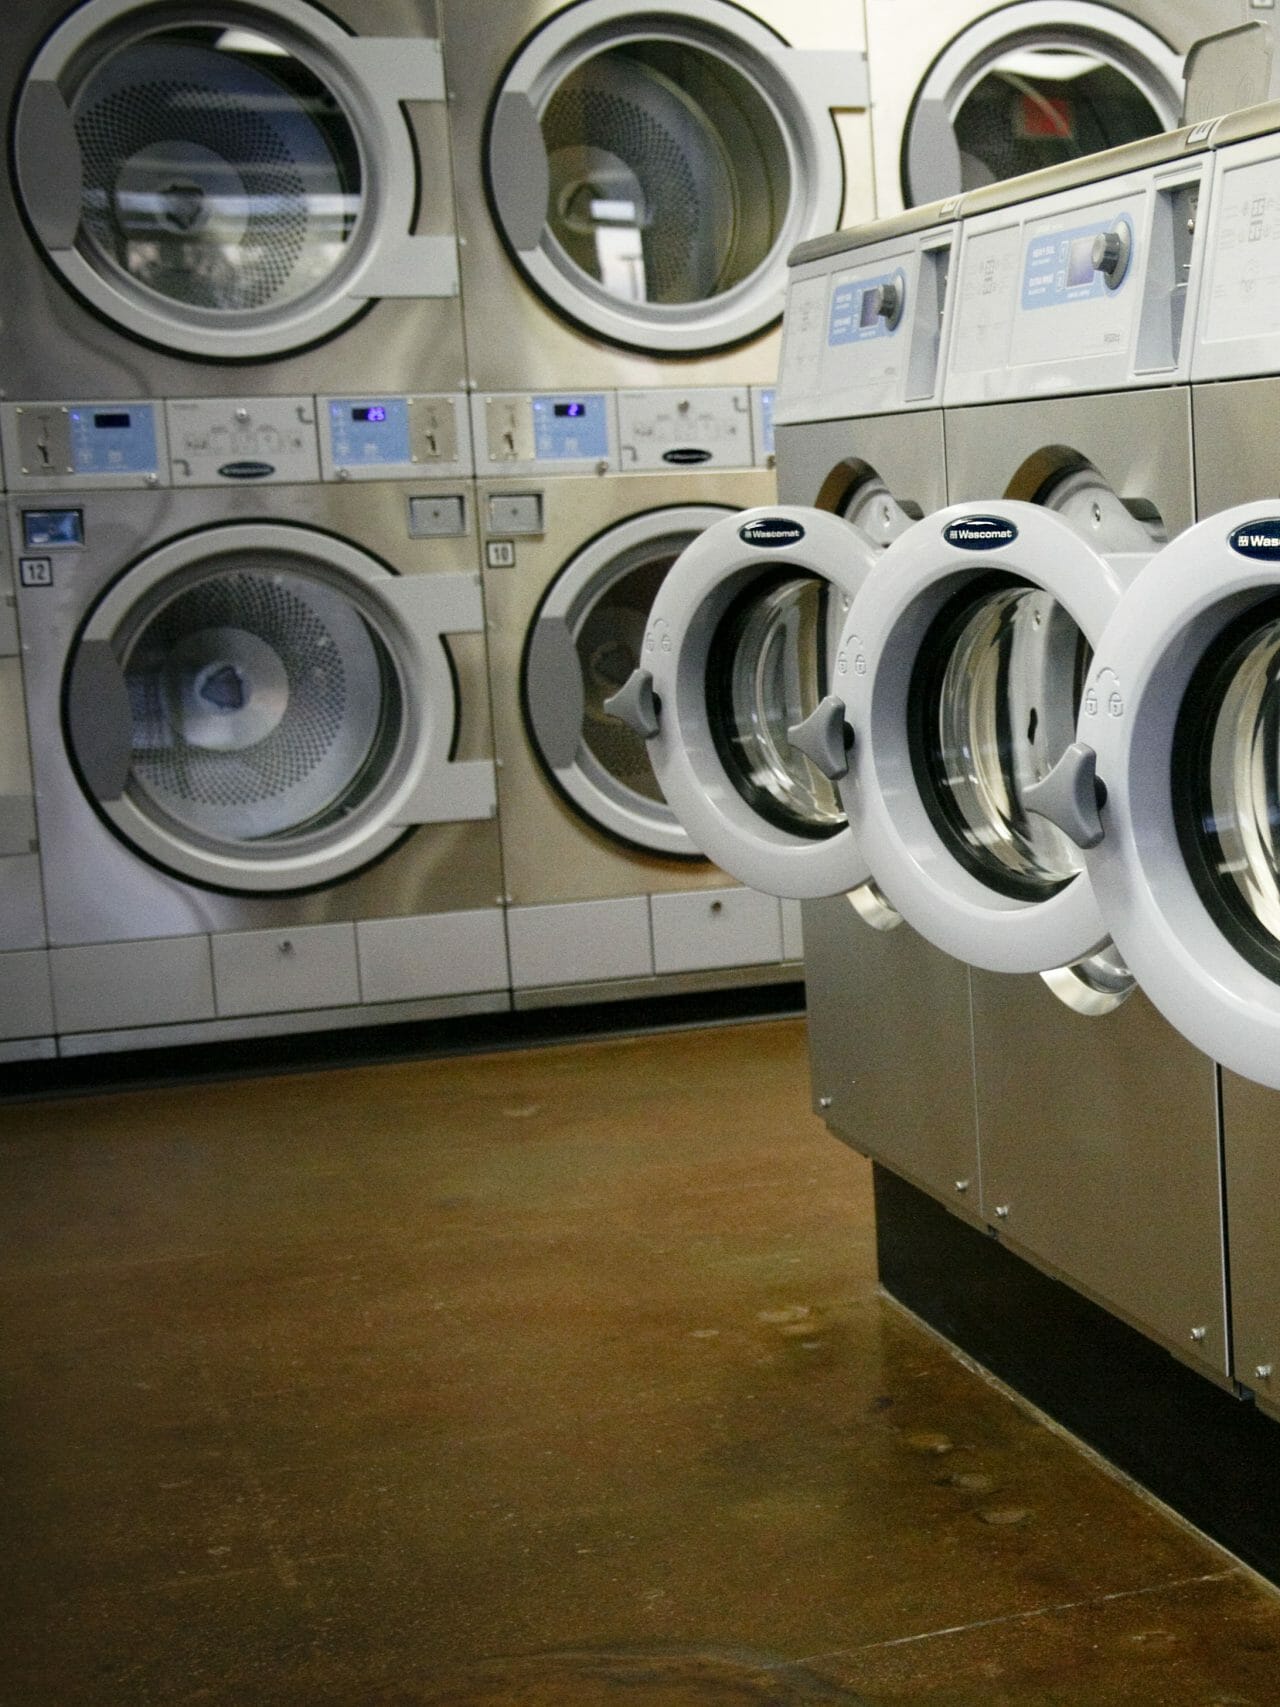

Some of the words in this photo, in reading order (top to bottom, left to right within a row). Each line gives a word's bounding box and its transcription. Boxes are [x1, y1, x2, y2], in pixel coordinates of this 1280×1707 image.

[752, 529, 800, 539] Wascomat
[958, 529, 1013, 540] Wascomat
[28, 563, 46, 581] 12
